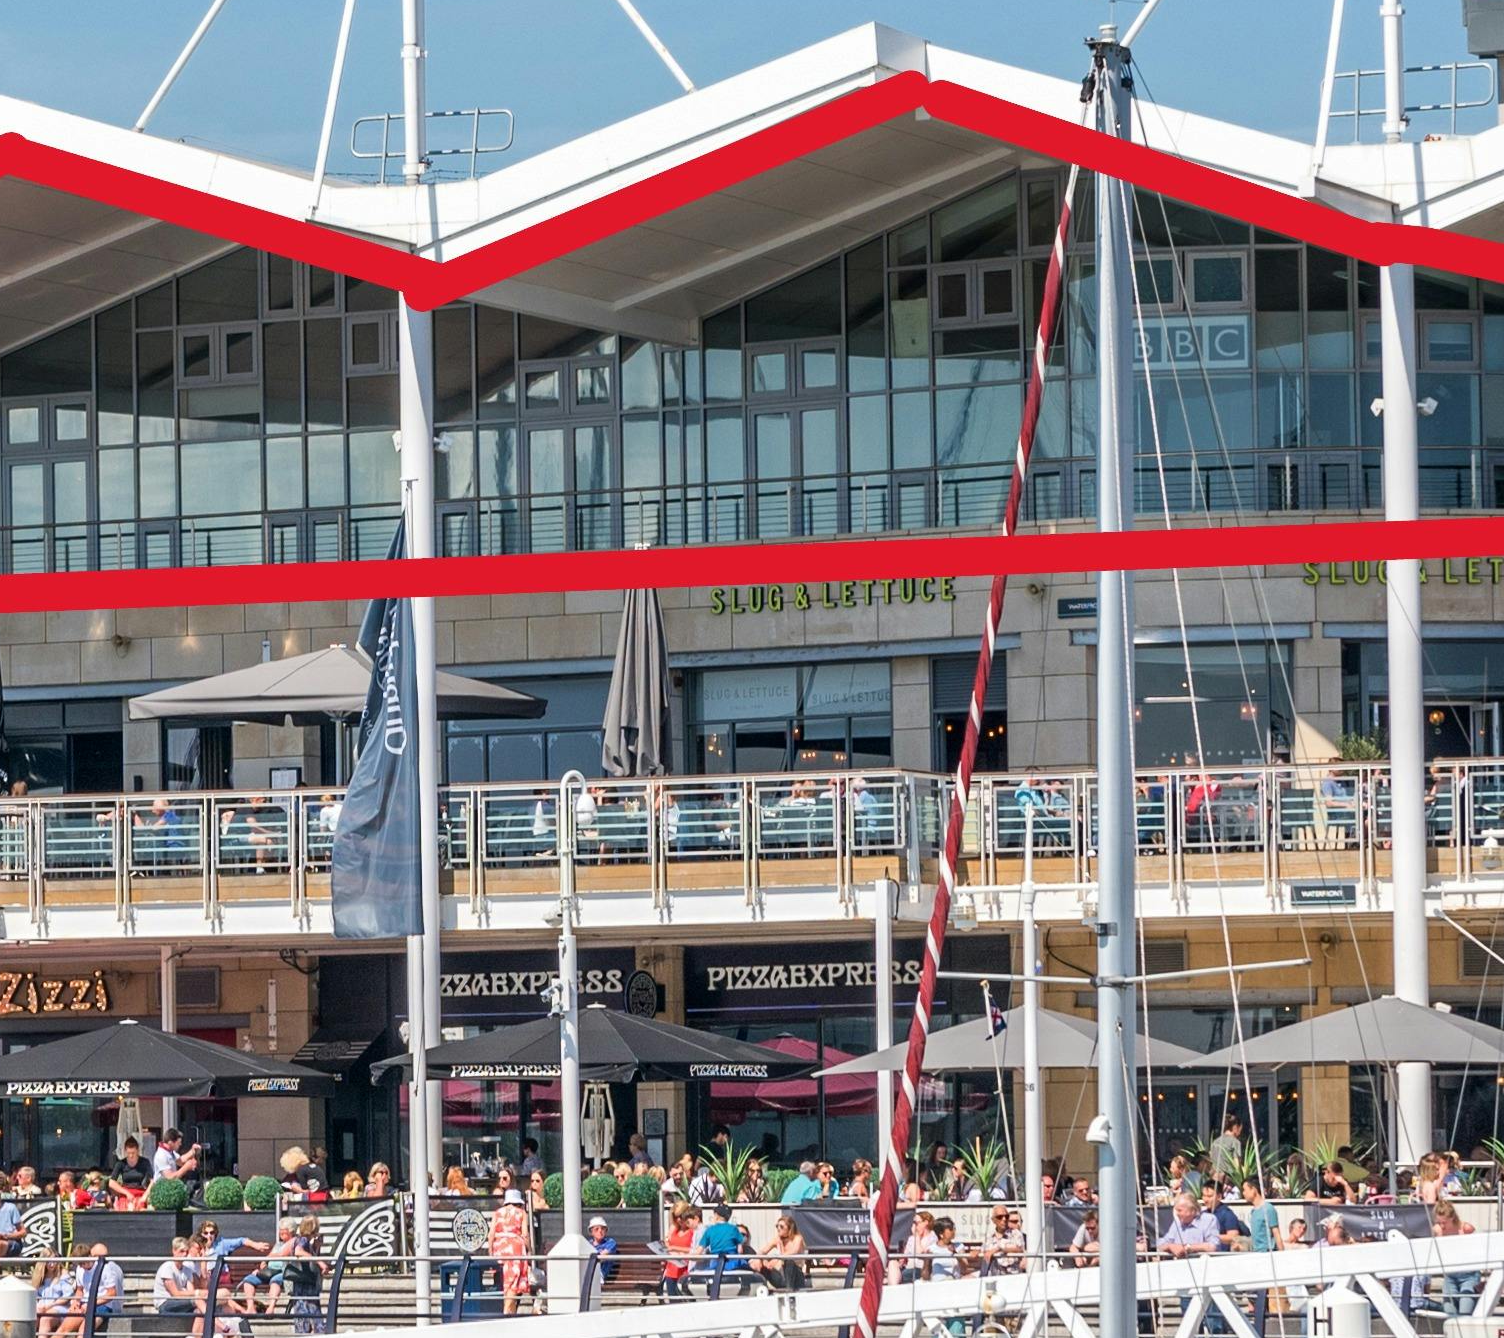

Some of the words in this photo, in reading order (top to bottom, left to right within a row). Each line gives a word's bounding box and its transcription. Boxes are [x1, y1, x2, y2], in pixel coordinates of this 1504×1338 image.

[1134, 329, 1239, 359] BBC
[711, 584, 783, 614] SLUG
[794, 583, 809, 610] &
[822, 577, 956, 609] LETTUCE
[1313, 1306, 1333, 1336] H
